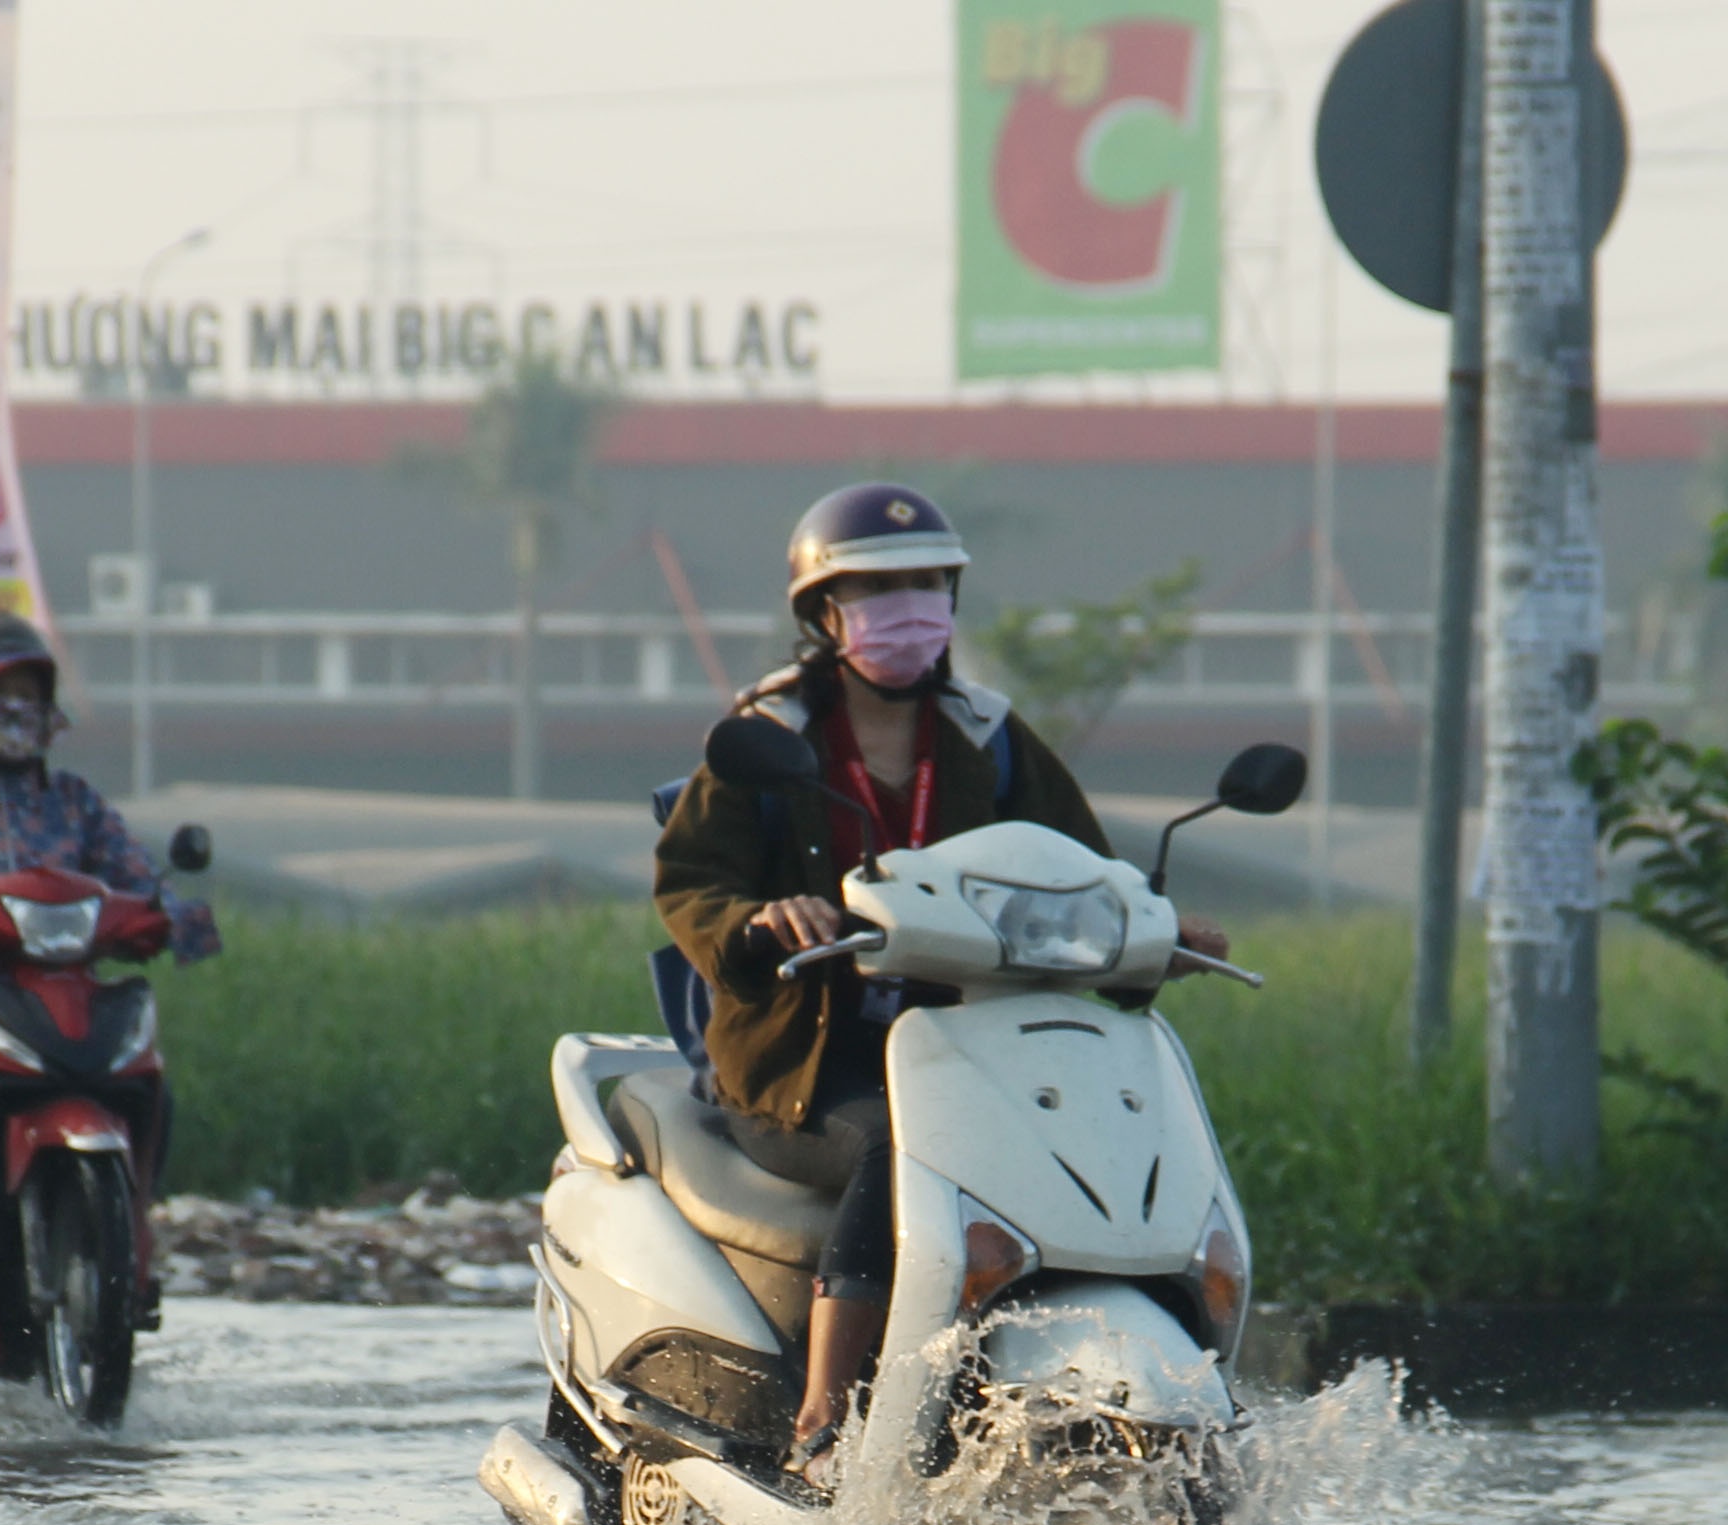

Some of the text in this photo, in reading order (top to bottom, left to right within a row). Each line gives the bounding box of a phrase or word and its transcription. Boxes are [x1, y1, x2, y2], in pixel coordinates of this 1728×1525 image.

[983, 17, 1108, 107] Big
[990, 18, 1208, 294] C
[10, 291, 223, 371] HƯƠNG
[394, 302, 503, 371] BIG
